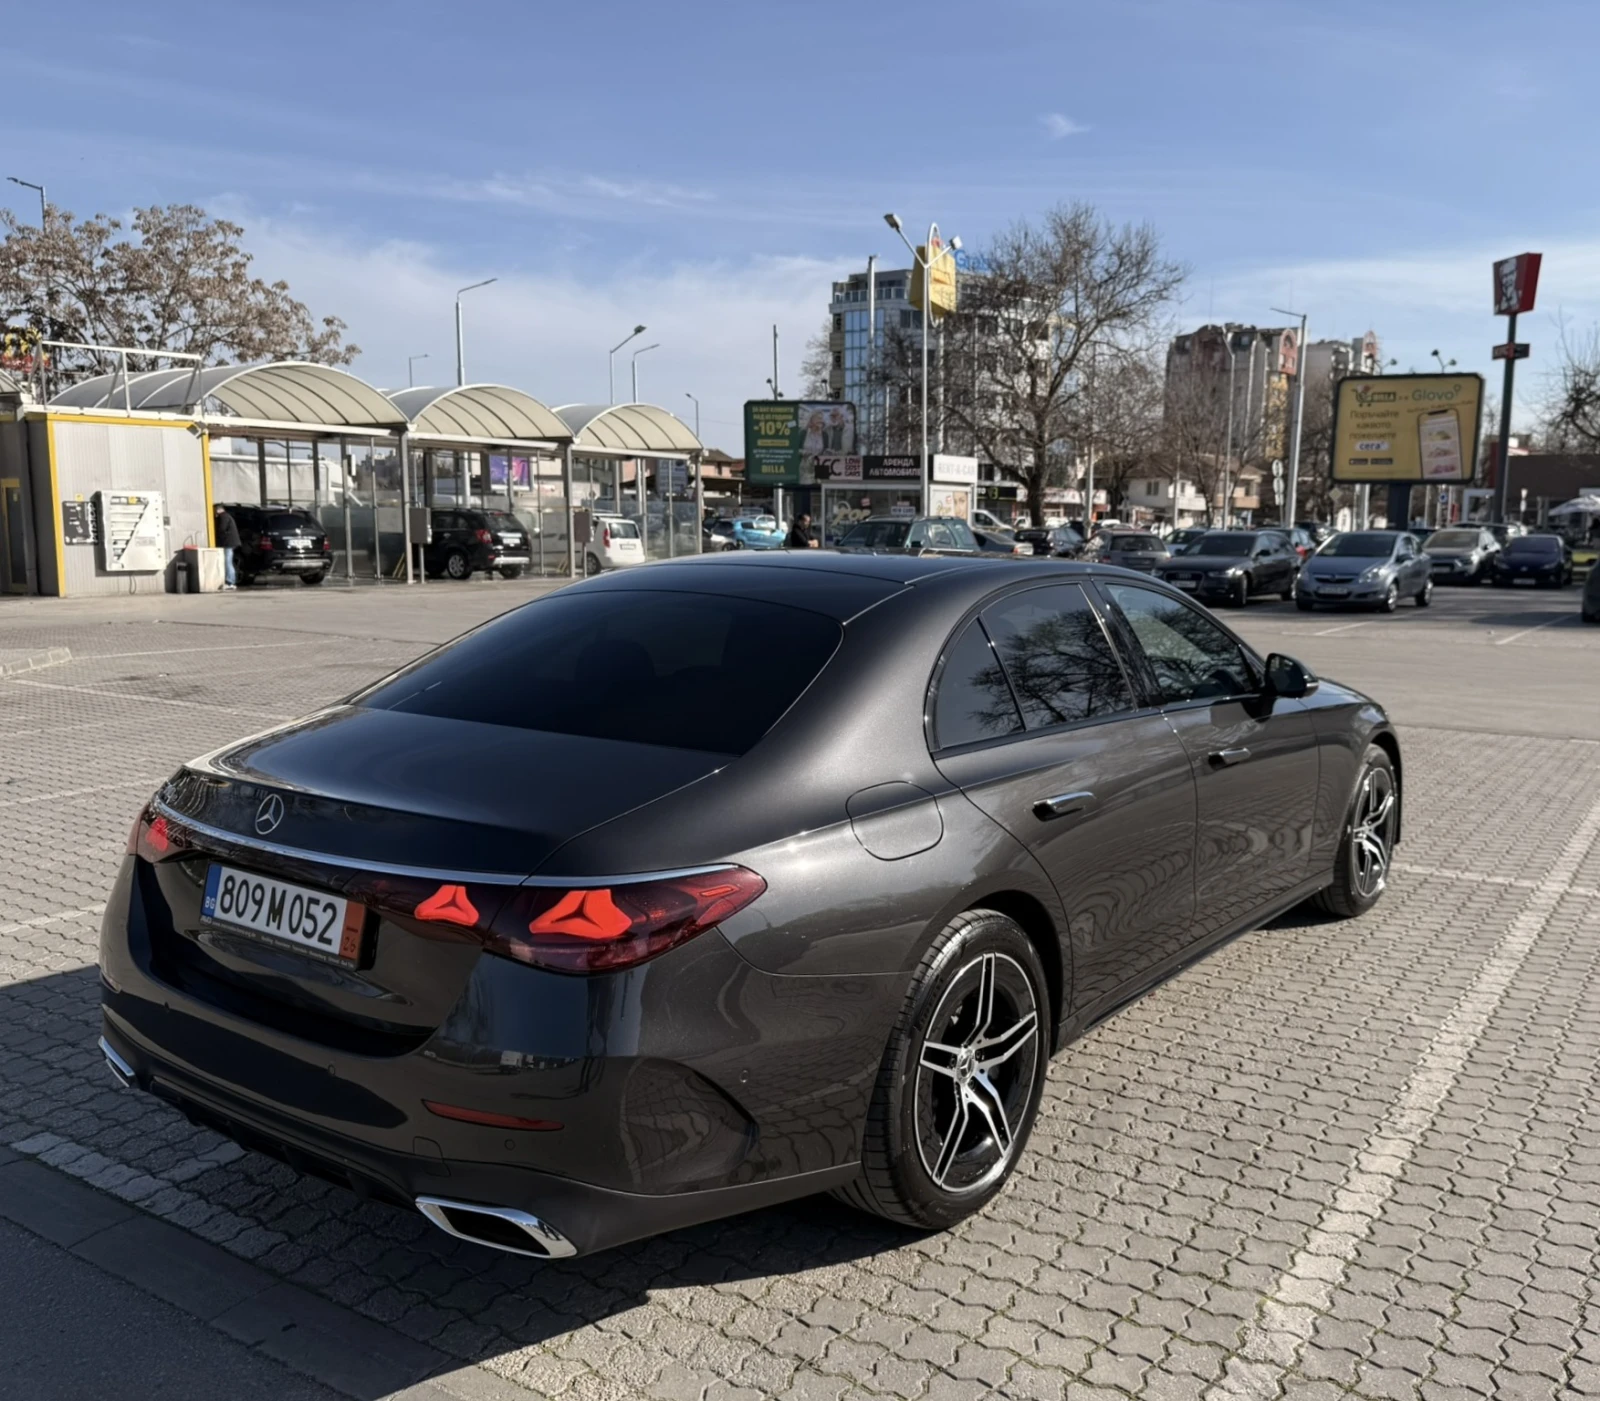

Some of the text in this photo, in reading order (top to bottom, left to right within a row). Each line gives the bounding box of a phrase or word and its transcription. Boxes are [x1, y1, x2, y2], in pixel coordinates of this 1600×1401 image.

[1411, 384, 1461, 402] Glovo
[753, 421, 791, 436] -10%
[761, 465, 785, 473] BILLA
[882, 458, 914, 467] АРЕНДА
[204, 896, 216, 910] BG
[220, 875, 337, 946] 809 M 052
